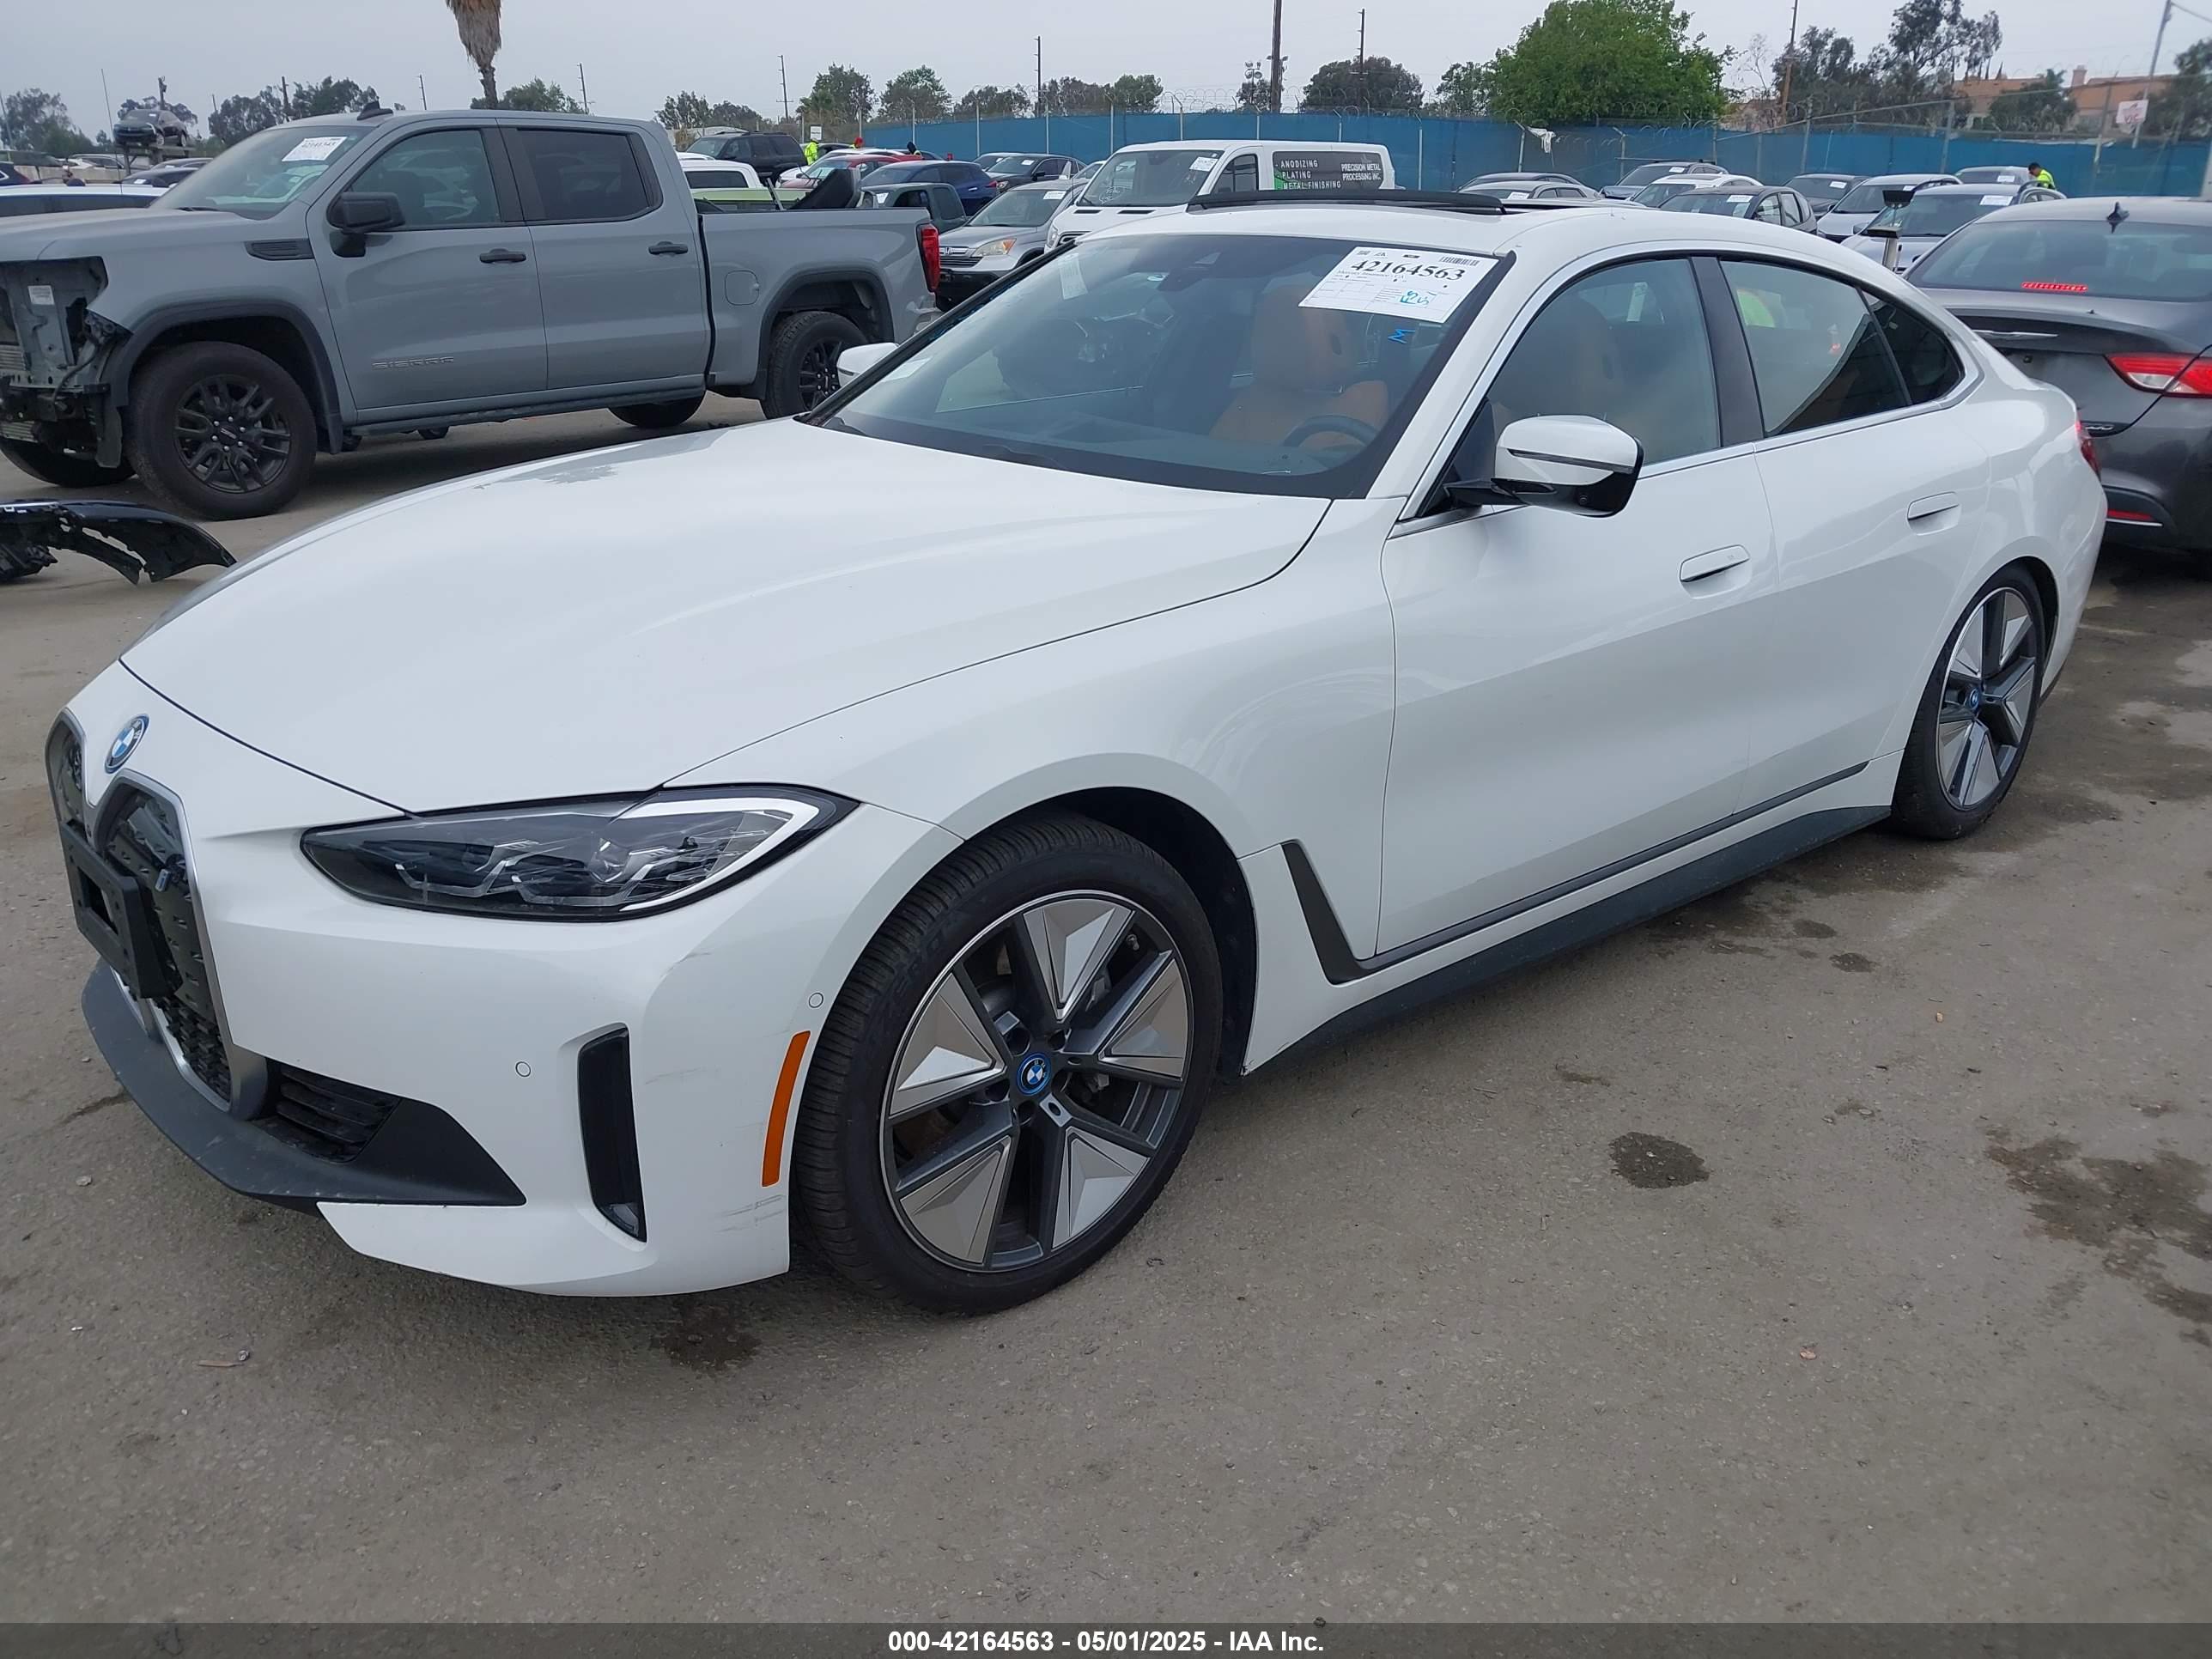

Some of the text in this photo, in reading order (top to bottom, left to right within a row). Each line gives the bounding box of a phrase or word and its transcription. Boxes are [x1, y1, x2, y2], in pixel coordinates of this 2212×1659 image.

[1280, 160, 1318, 168] ANODIZING
[1341, 163, 1366, 172] PRECISION
[1282, 171, 1311, 179] PLATING
[1342, 173, 1371, 181] PROCESSING
[1283, 180, 1341, 190] METAL FINISHING
[1351, 259, 1467, 281] 42164563
[371, 356, 454, 370] SIERRA
